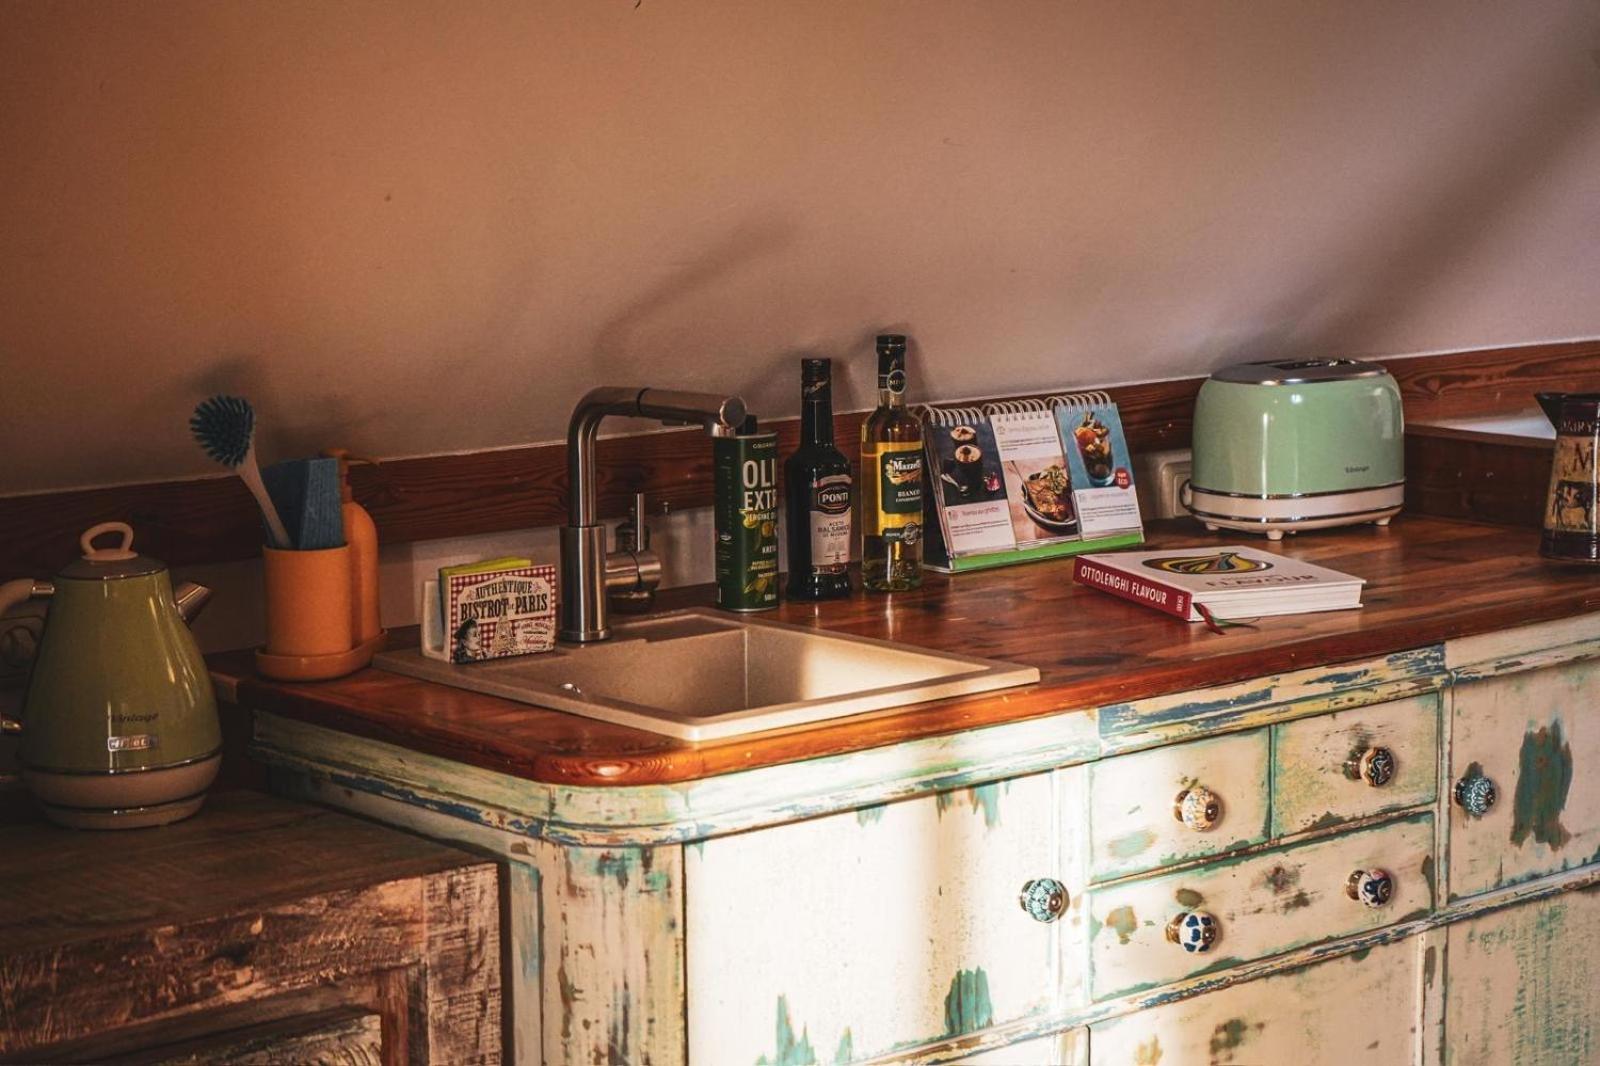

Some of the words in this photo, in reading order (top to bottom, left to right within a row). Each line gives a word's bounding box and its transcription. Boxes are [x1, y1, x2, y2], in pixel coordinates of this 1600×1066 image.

[822, 492, 848, 503] PONTI
[475, 580, 533, 600] AUTHENTIQUE
[1080, 564, 1130, 592] OTTOLENGHI
[1131, 582, 1168, 606] FLAVOUR
[1205, 574, 1318, 587] FLAVOUR
[460, 598, 509, 621] BISTROT
[514, 593, 548, 615] PARIS
